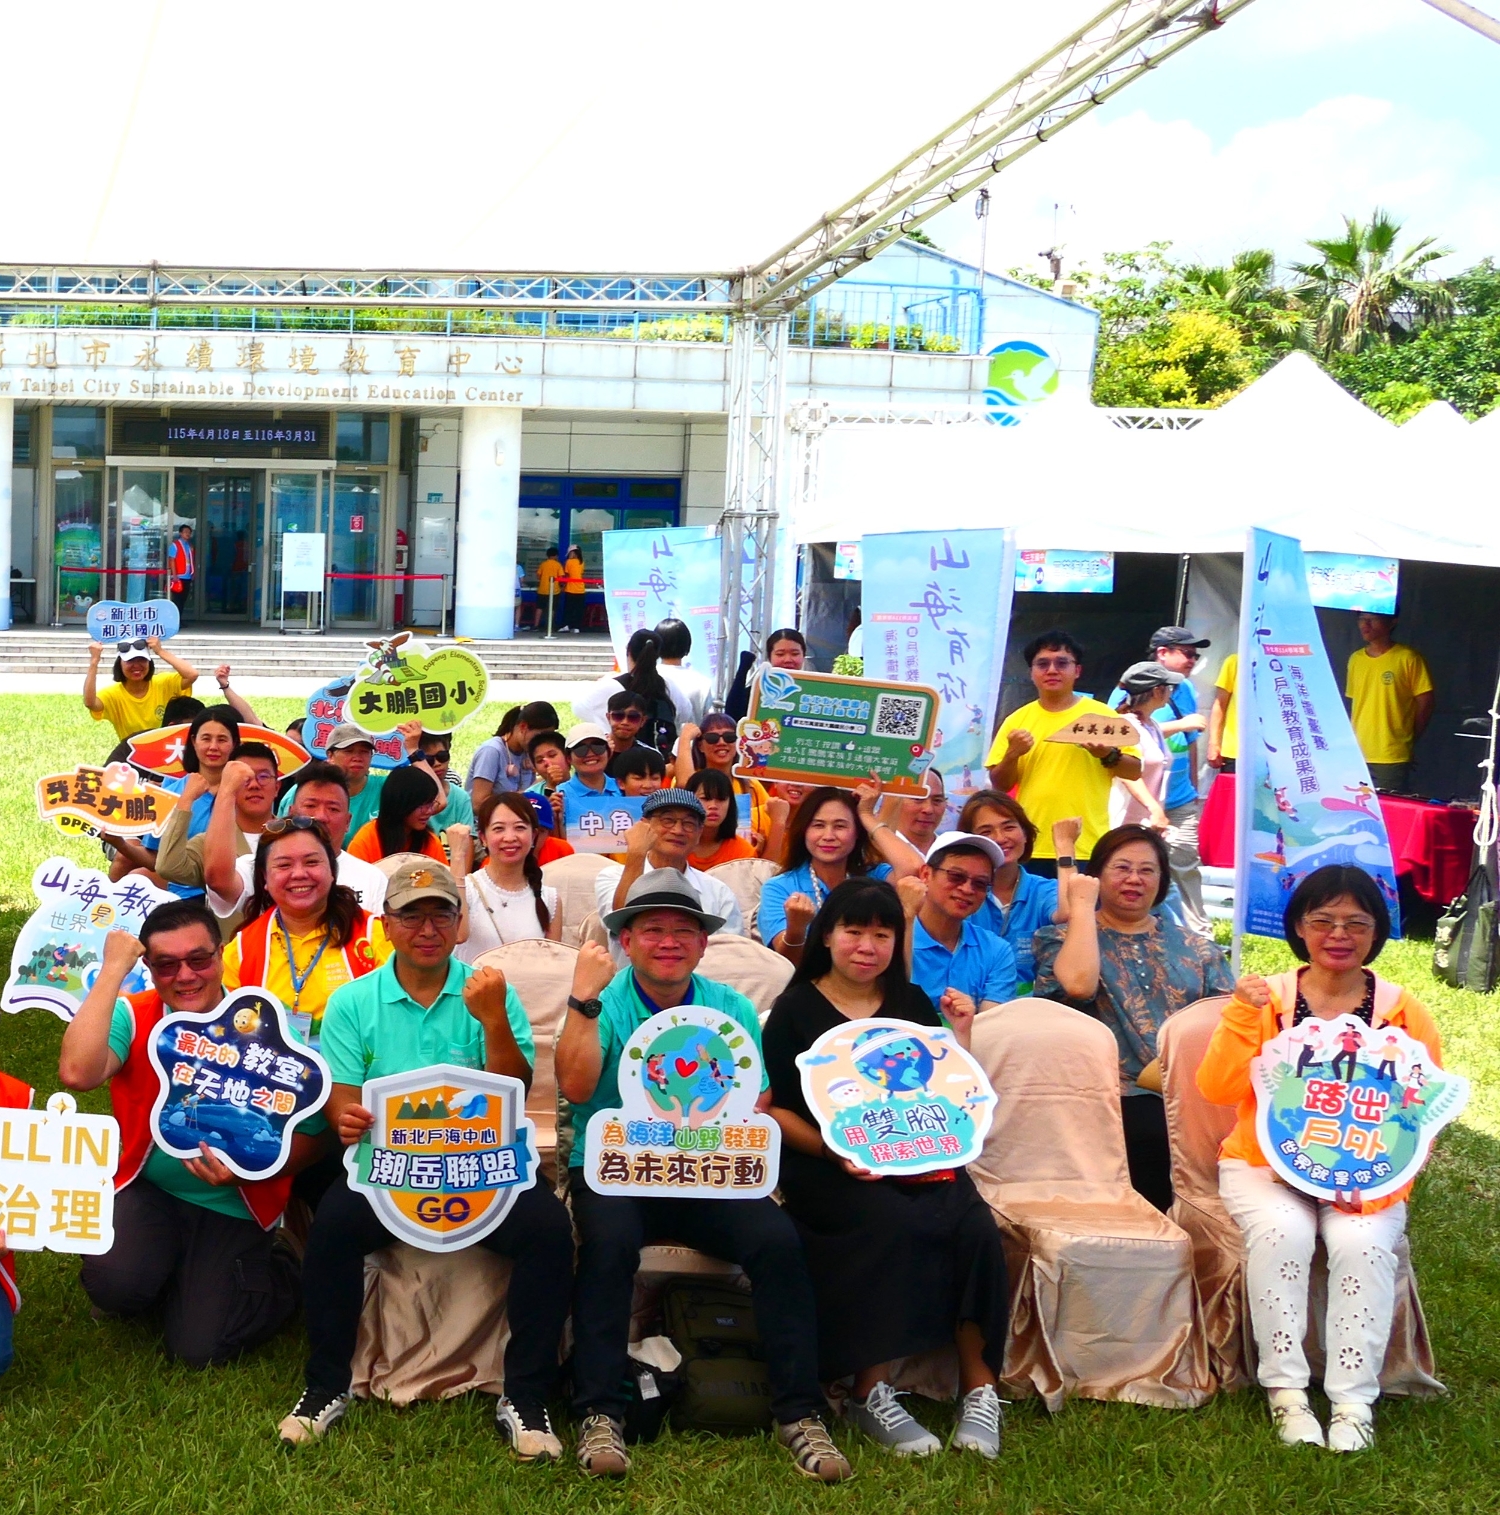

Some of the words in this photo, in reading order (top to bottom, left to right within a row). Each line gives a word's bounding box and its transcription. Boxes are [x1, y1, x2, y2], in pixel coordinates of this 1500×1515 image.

[20, 377, 74, 397] Taipei
[83, 378, 120, 396] City
[129, 378, 234, 395] Sustainable
[242, 382, 358, 400] Development
[367, 384, 456, 401] Education
[465, 386, 523, 402] Center
[102, 622, 165, 638] 和美國小
[110, 606, 158, 621] 新北市
[422, 652, 447, 672] Dapeng
[450, 650, 482, 677] Elementary
[474, 680, 485, 703] School
[358, 680, 476, 715] 大鵬國小
[1072, 723, 1130, 736] 和美創客
[1274, 676, 1321, 794] 戶海教育成果展
[46, 769, 157, 822] 我愛大鵬
[61, 816, 98, 838] DPES
[40, 866, 160, 919] 山海教
[51, 905, 140, 936] 世界是
[170, 1062, 296, 1116] 在天地之間
[1302, 1077, 1390, 1123] 踏出
[63, 1127, 110, 1167] IN
[389, 1127, 498, 1147] 新北戶海中心
[601, 1120, 770, 1151] 為海洋山野發聲
[872, 1136, 965, 1165] 探索世界
[1298, 1116, 1390, 1163] 戶外
[370, 1149, 520, 1189] 潮岳聯盟
[598, 1151, 767, 1188] 為未來行動
[1280, 1139, 1393, 1187] 世界就是你的
[415, 1195, 472, 1225] GO
